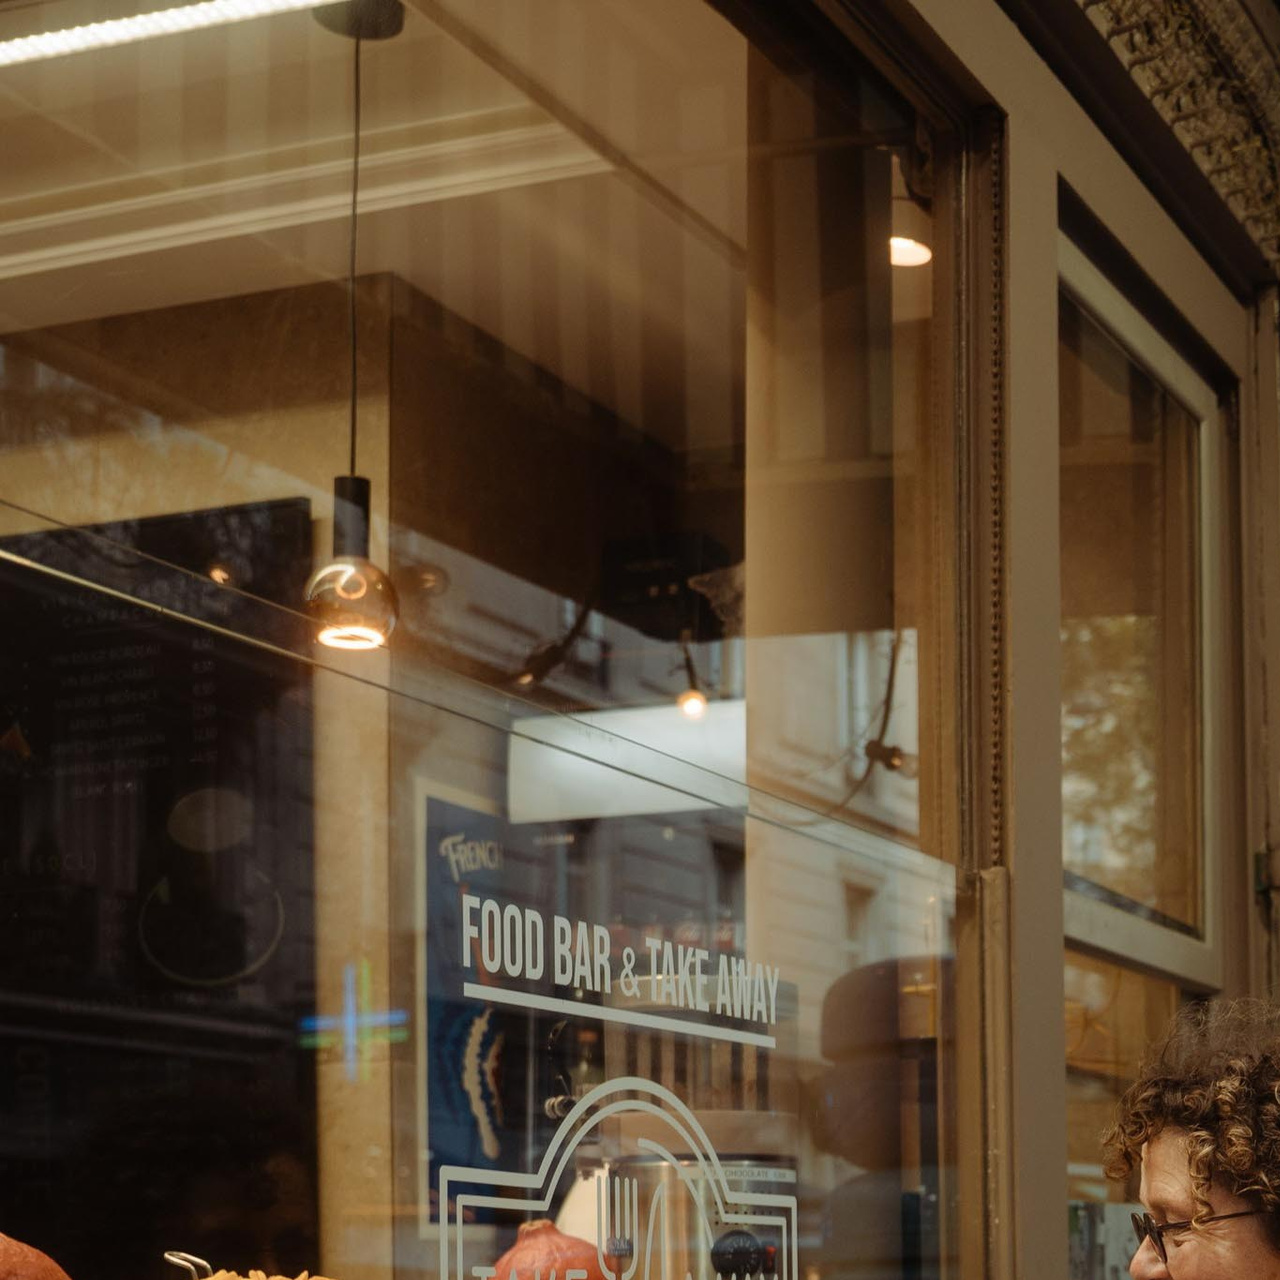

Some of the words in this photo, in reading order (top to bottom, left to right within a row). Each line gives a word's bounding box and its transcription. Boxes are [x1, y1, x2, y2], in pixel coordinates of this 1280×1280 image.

[462, 893, 545, 981] FOOD
[554, 914, 612, 994] BAR
[619, 946, 641, 998] &
[645, 936, 710, 1013] TAKE
[716, 952, 780, 1025] AWAY
